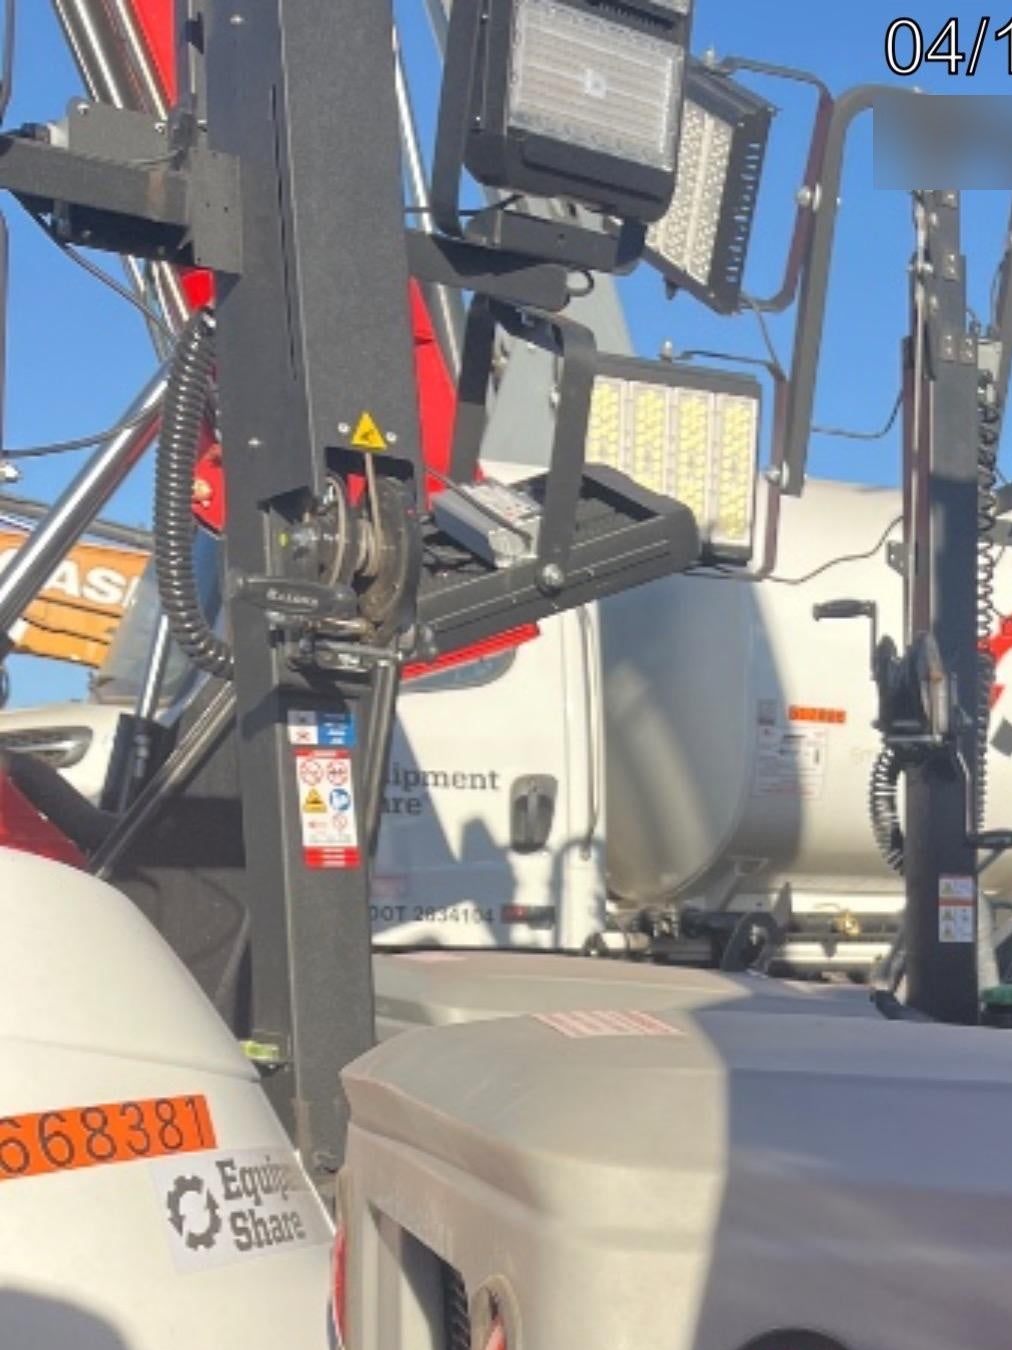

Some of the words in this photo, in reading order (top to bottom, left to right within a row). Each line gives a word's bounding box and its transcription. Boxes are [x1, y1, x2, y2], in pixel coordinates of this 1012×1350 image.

[387, 761, 500, 793] ipment
[0, 1098, 206, 1174] 668381
[229, 1208, 307, 1251] Share
